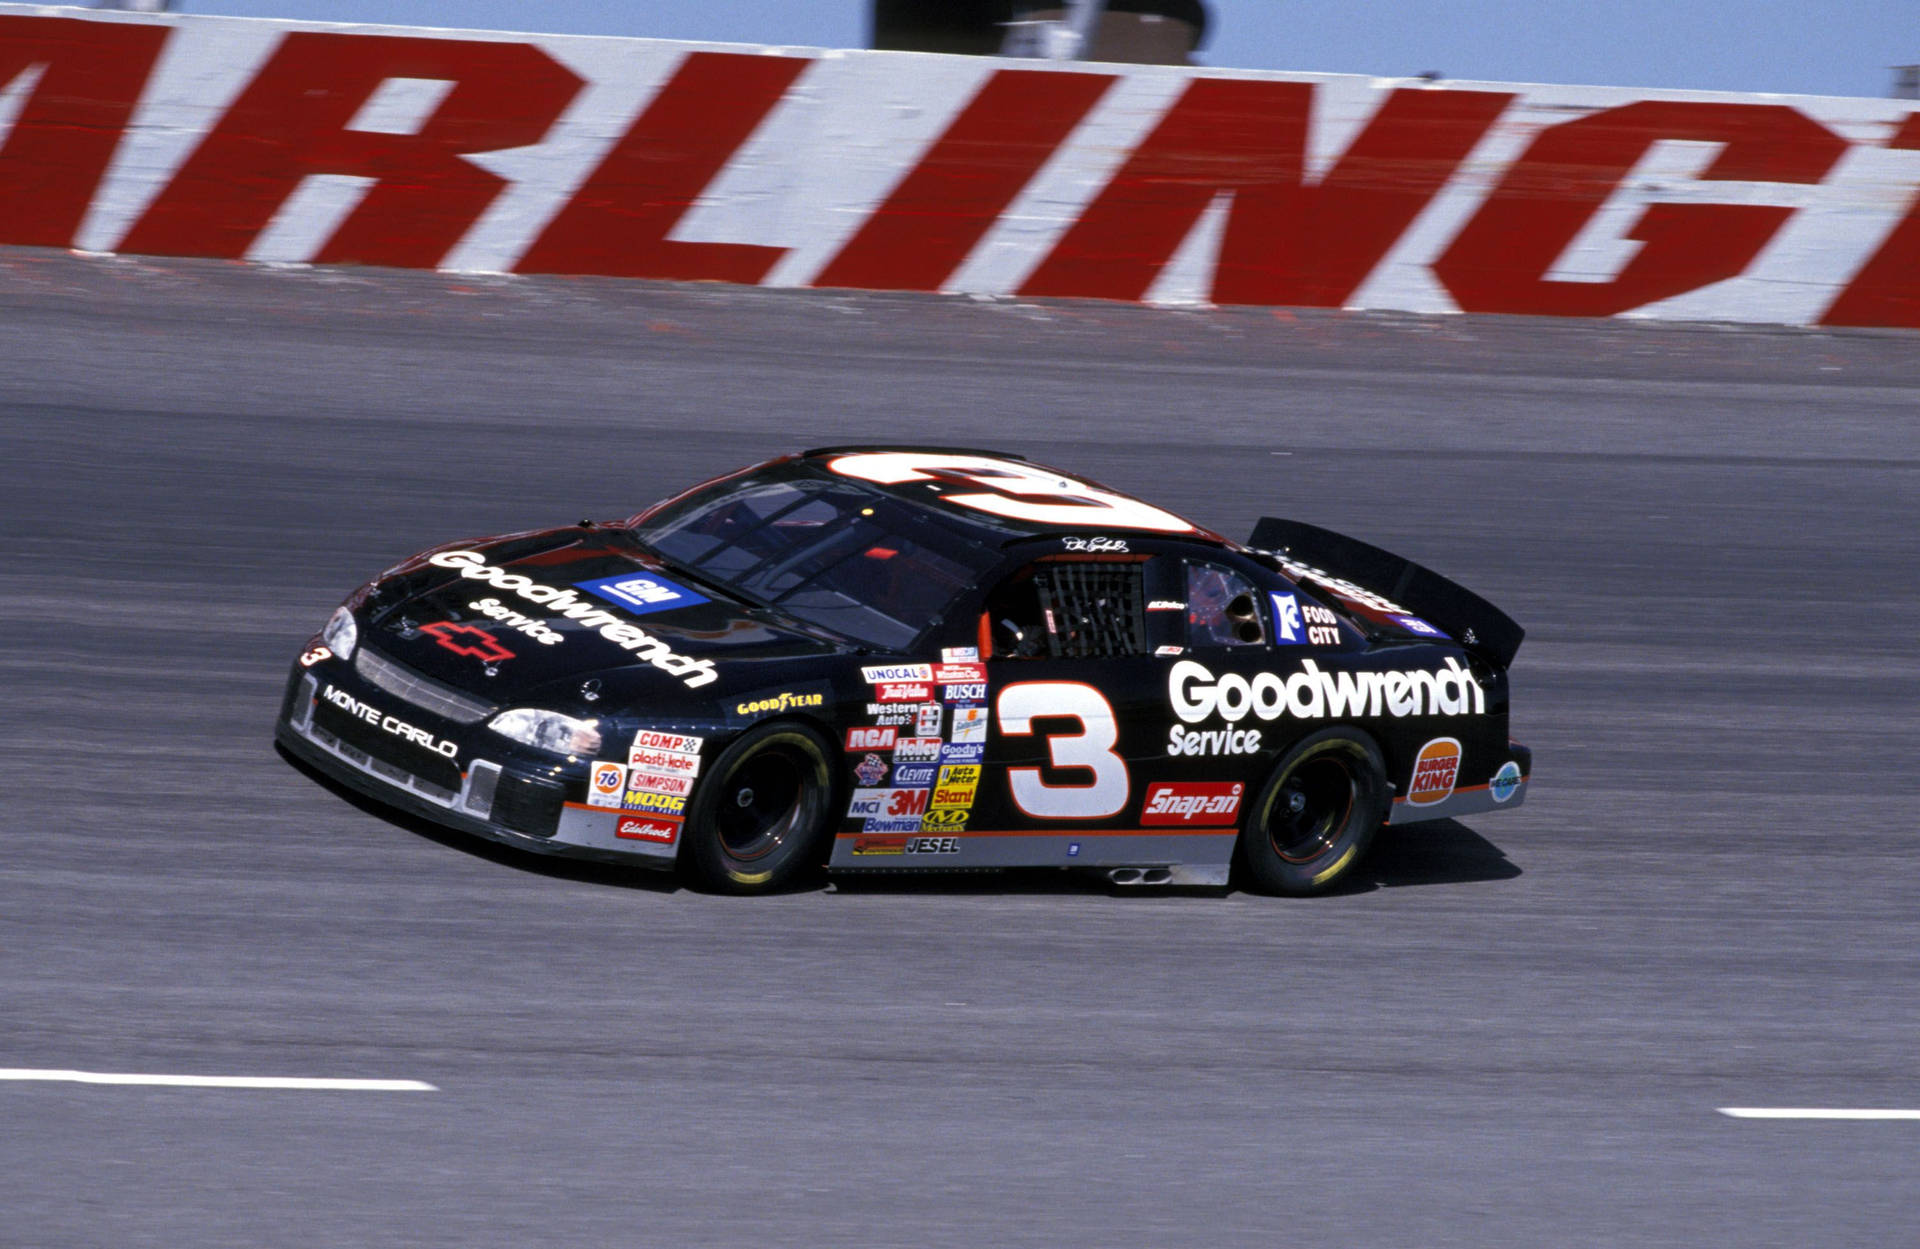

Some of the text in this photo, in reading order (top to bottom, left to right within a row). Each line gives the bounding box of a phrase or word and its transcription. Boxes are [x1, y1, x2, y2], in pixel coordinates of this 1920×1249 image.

[829, 452, 1196, 533] 3
[613, 579, 681, 602] GM
[430, 550, 718, 688] Goodwrench
[469, 598, 564, 645] Service
[1302, 605, 1336, 624] FOOD
[1308, 626, 1341, 645] CITY
[300, 647, 332, 667] 3
[866, 668, 919, 680] UNOCAL
[945, 684, 987, 699] BUSCH
[1168, 657, 1485, 723] Goodwrench
[867, 703, 918, 715] Western
[323, 684, 458, 758] MONTE CARLO
[876, 715, 905, 726] Auto
[639, 732, 684, 750] COMP
[850, 729, 895, 747] RCA
[1167, 723, 1262, 756] Service
[895, 738, 939, 760] Holley
[941, 743, 984, 757] Goody's
[996, 679, 1131, 820] 3
[632, 750, 694, 770] plasti-kote
[1417, 757, 1458, 774] BURGER
[599, 771, 618, 786] 76
[895, 766, 934, 781] CLEVITE
[951, 767, 974, 776] Auto
[1412, 770, 1455, 792] KING
[634, 773, 687, 792] SIMPSON
[622, 790, 687, 811] MOOG
[887, 790, 928, 815] 3M
[934, 789, 974, 804] Stant
[1145, 788, 1241, 820] Snap-on
[851, 802, 880, 814] MCI
[620, 821, 673, 839] Edelbrock
[863, 818, 920, 832] Bowman
[906, 838, 960, 853] JESEL
